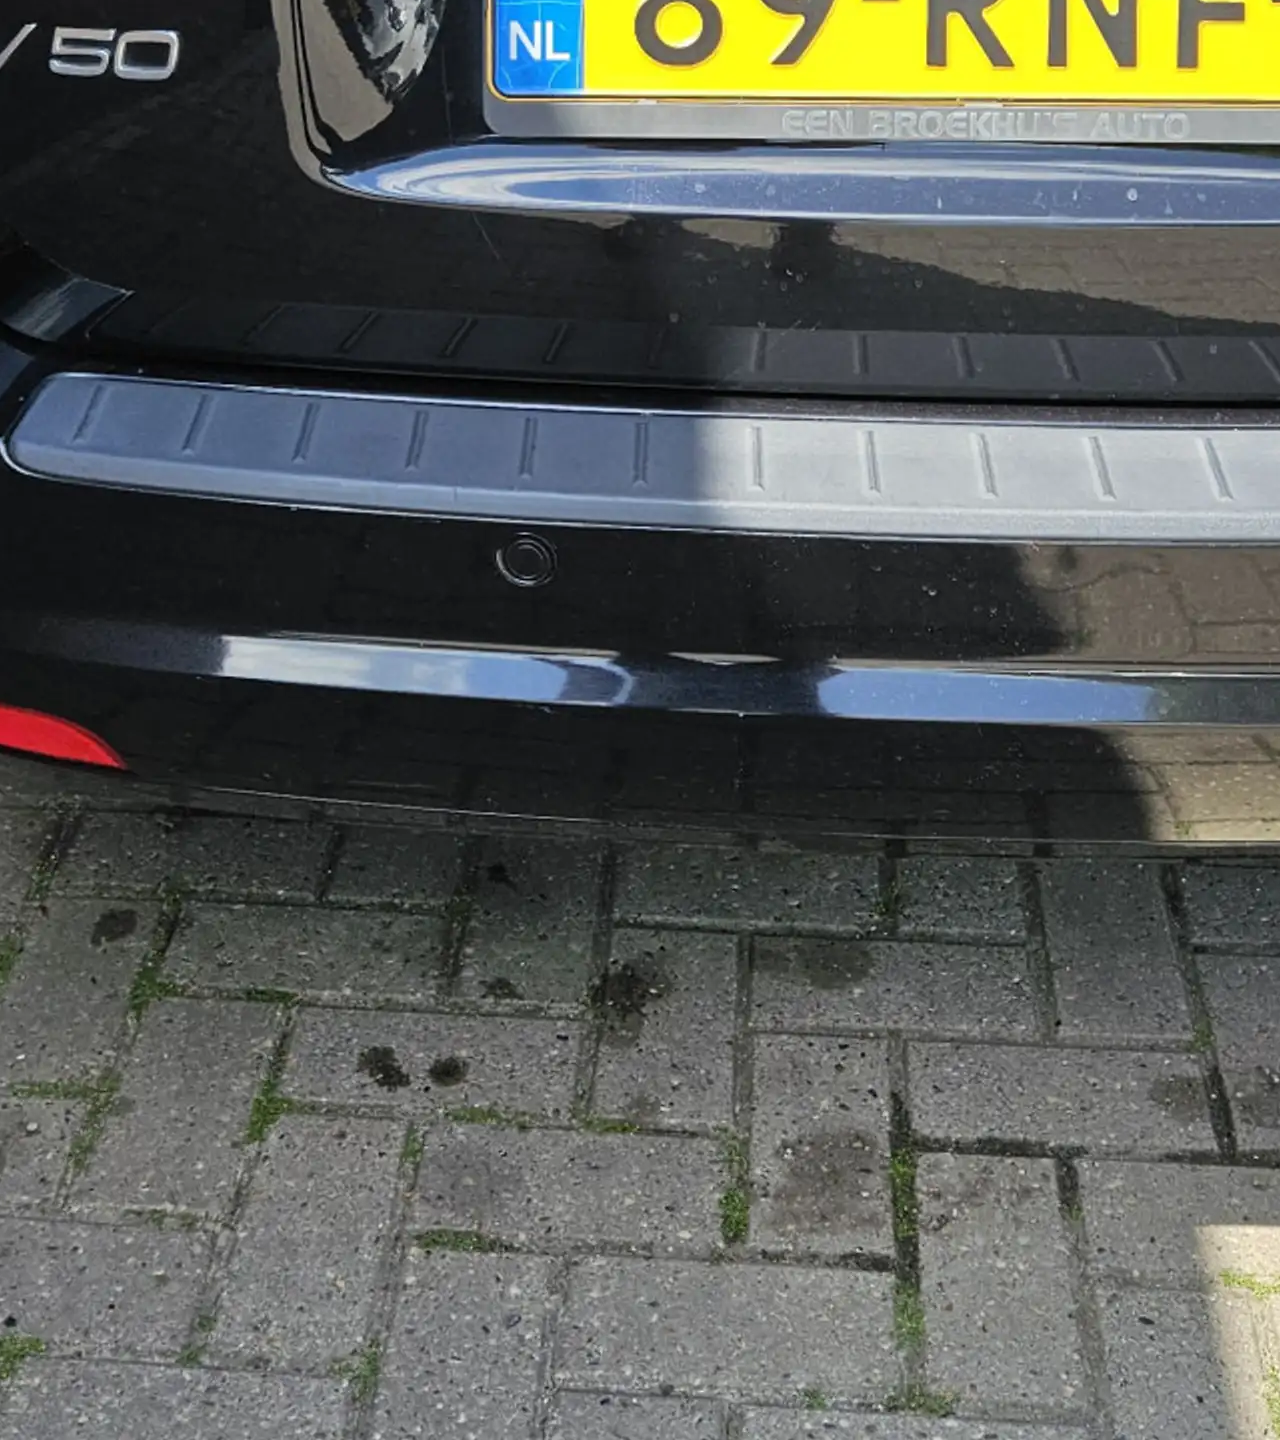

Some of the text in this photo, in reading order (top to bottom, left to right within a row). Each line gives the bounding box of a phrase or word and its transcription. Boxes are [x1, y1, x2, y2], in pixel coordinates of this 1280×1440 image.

[509, 20, 571, 61] NL
[782, 109, 854, 138] EEN
[1089, 111, 1190, 140] AUTO
